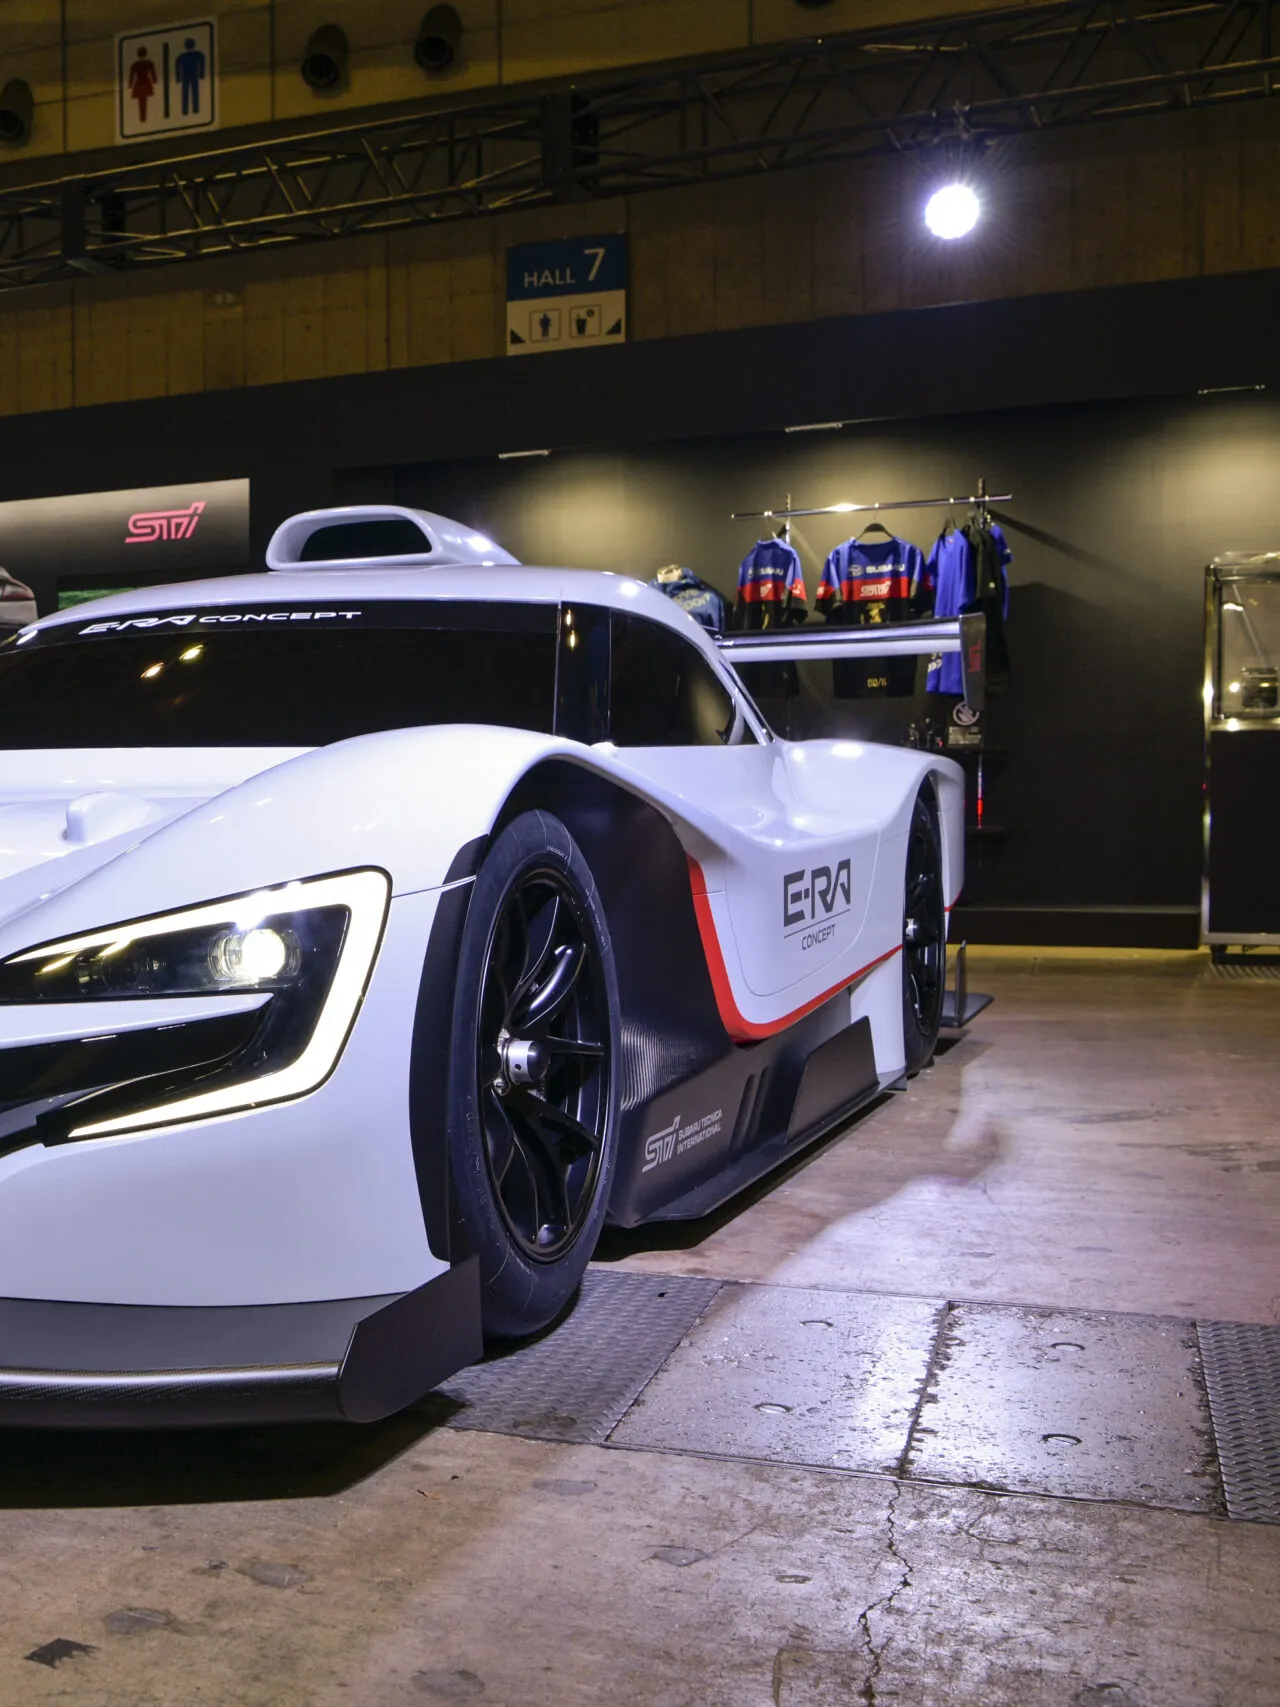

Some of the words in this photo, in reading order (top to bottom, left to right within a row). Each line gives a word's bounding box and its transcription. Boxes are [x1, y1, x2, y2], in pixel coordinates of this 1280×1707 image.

[524, 267, 576, 289] HALL
[583, 247, 605, 282] 7
[199, 611, 362, 624] CONCEPT
[801, 923, 836, 951] CONCEPT
[677, 1123, 722, 1155] INTERNATIONAL
[678, 1120, 700, 1141] SUBARU
[701, 1109, 723, 1127] TECNICA
